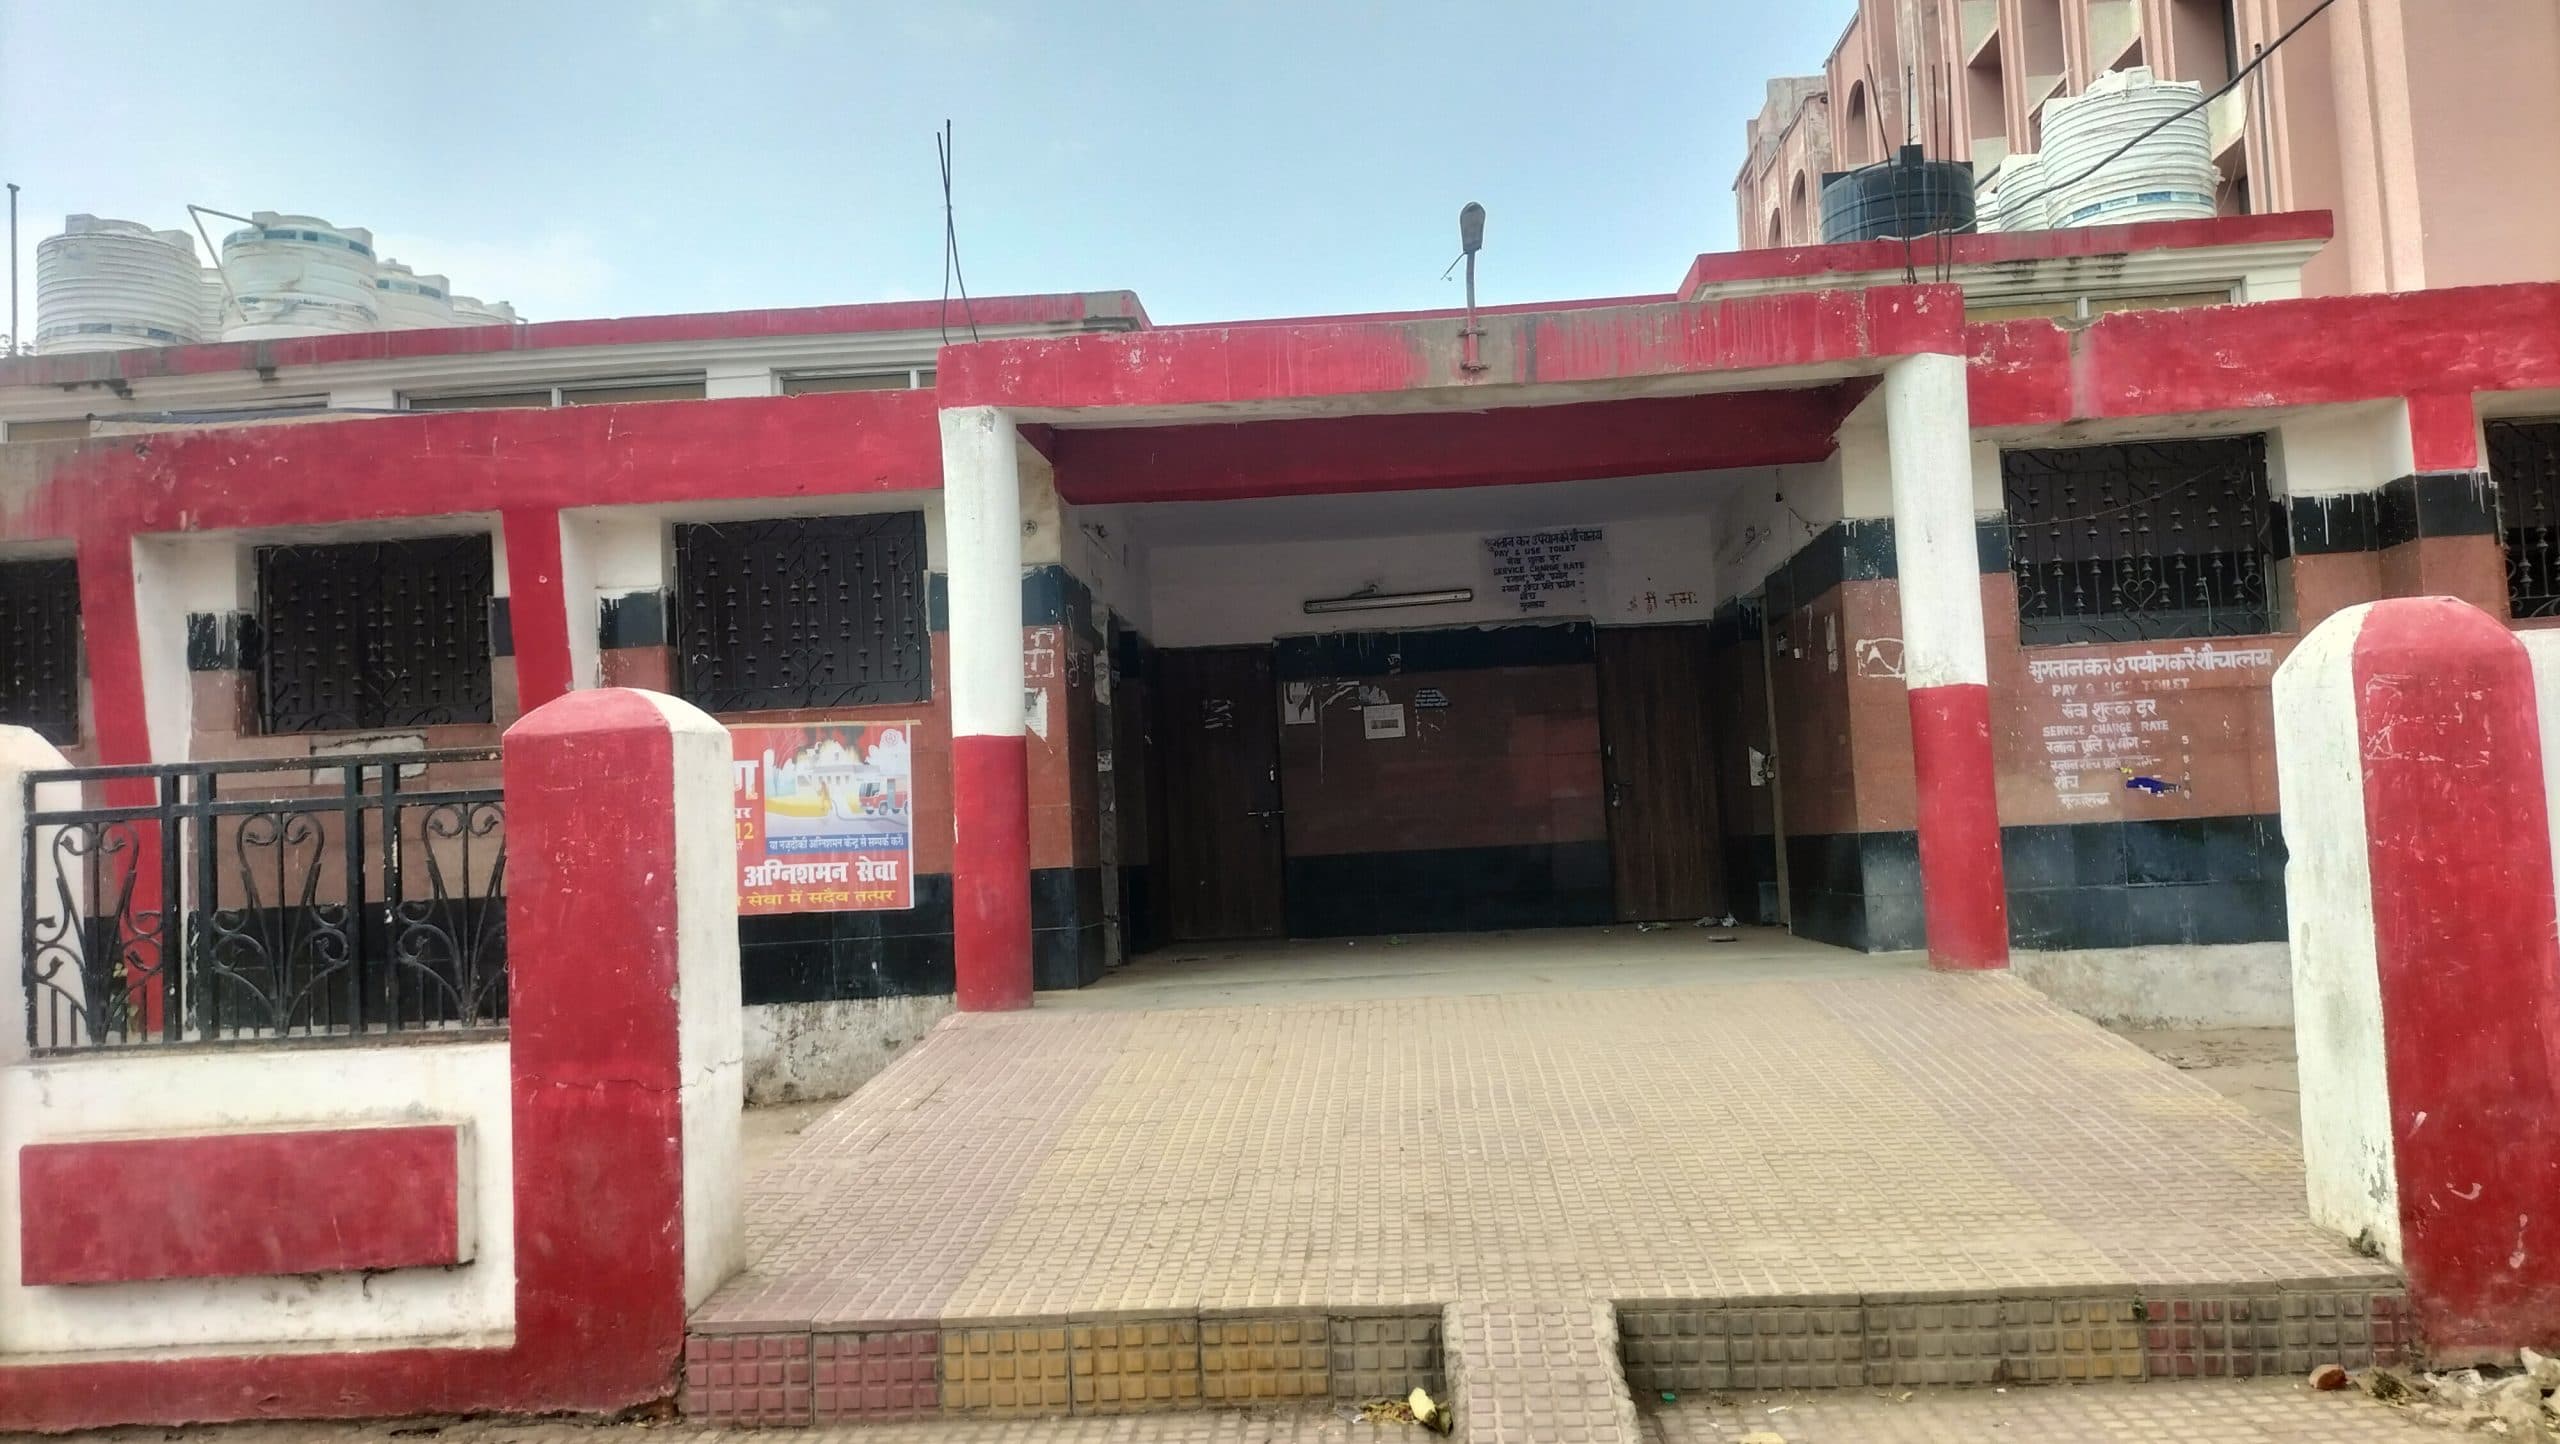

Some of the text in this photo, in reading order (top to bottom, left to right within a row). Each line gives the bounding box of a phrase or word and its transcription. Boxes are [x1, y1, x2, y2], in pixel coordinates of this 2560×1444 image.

[1494, 550, 1509, 558] PAY
[1524, 547, 1541, 555] USE
[1549, 544, 1576, 553] TOILET
[1493, 561, 1585, 576] SERVICE CHARGE RATE
[2028, 643, 2274, 684] भुगतान कर उपयोग करें शौचालय
[2052, 683, 2078, 697] PAY
[2091, 700, 2133, 722] शुल्क
[2134, 698, 2158, 717] दर
[2042, 720, 2170, 737] SERVICE CHARGE RATE
[2044, 740, 2077, 754] स्नान
[2077, 735, 2103, 754] प्रति
[2181, 735, 2190, 745] 5
[2053, 772, 2080, 791] शौच
[744, 856, 898, 887] अग्निशमन सेवा
[747, 891, 785, 907] सेवा
[788, 889, 803, 904] में
[808, 887, 848, 905] सदैव
[853, 889, 895, 904] तत्पर
